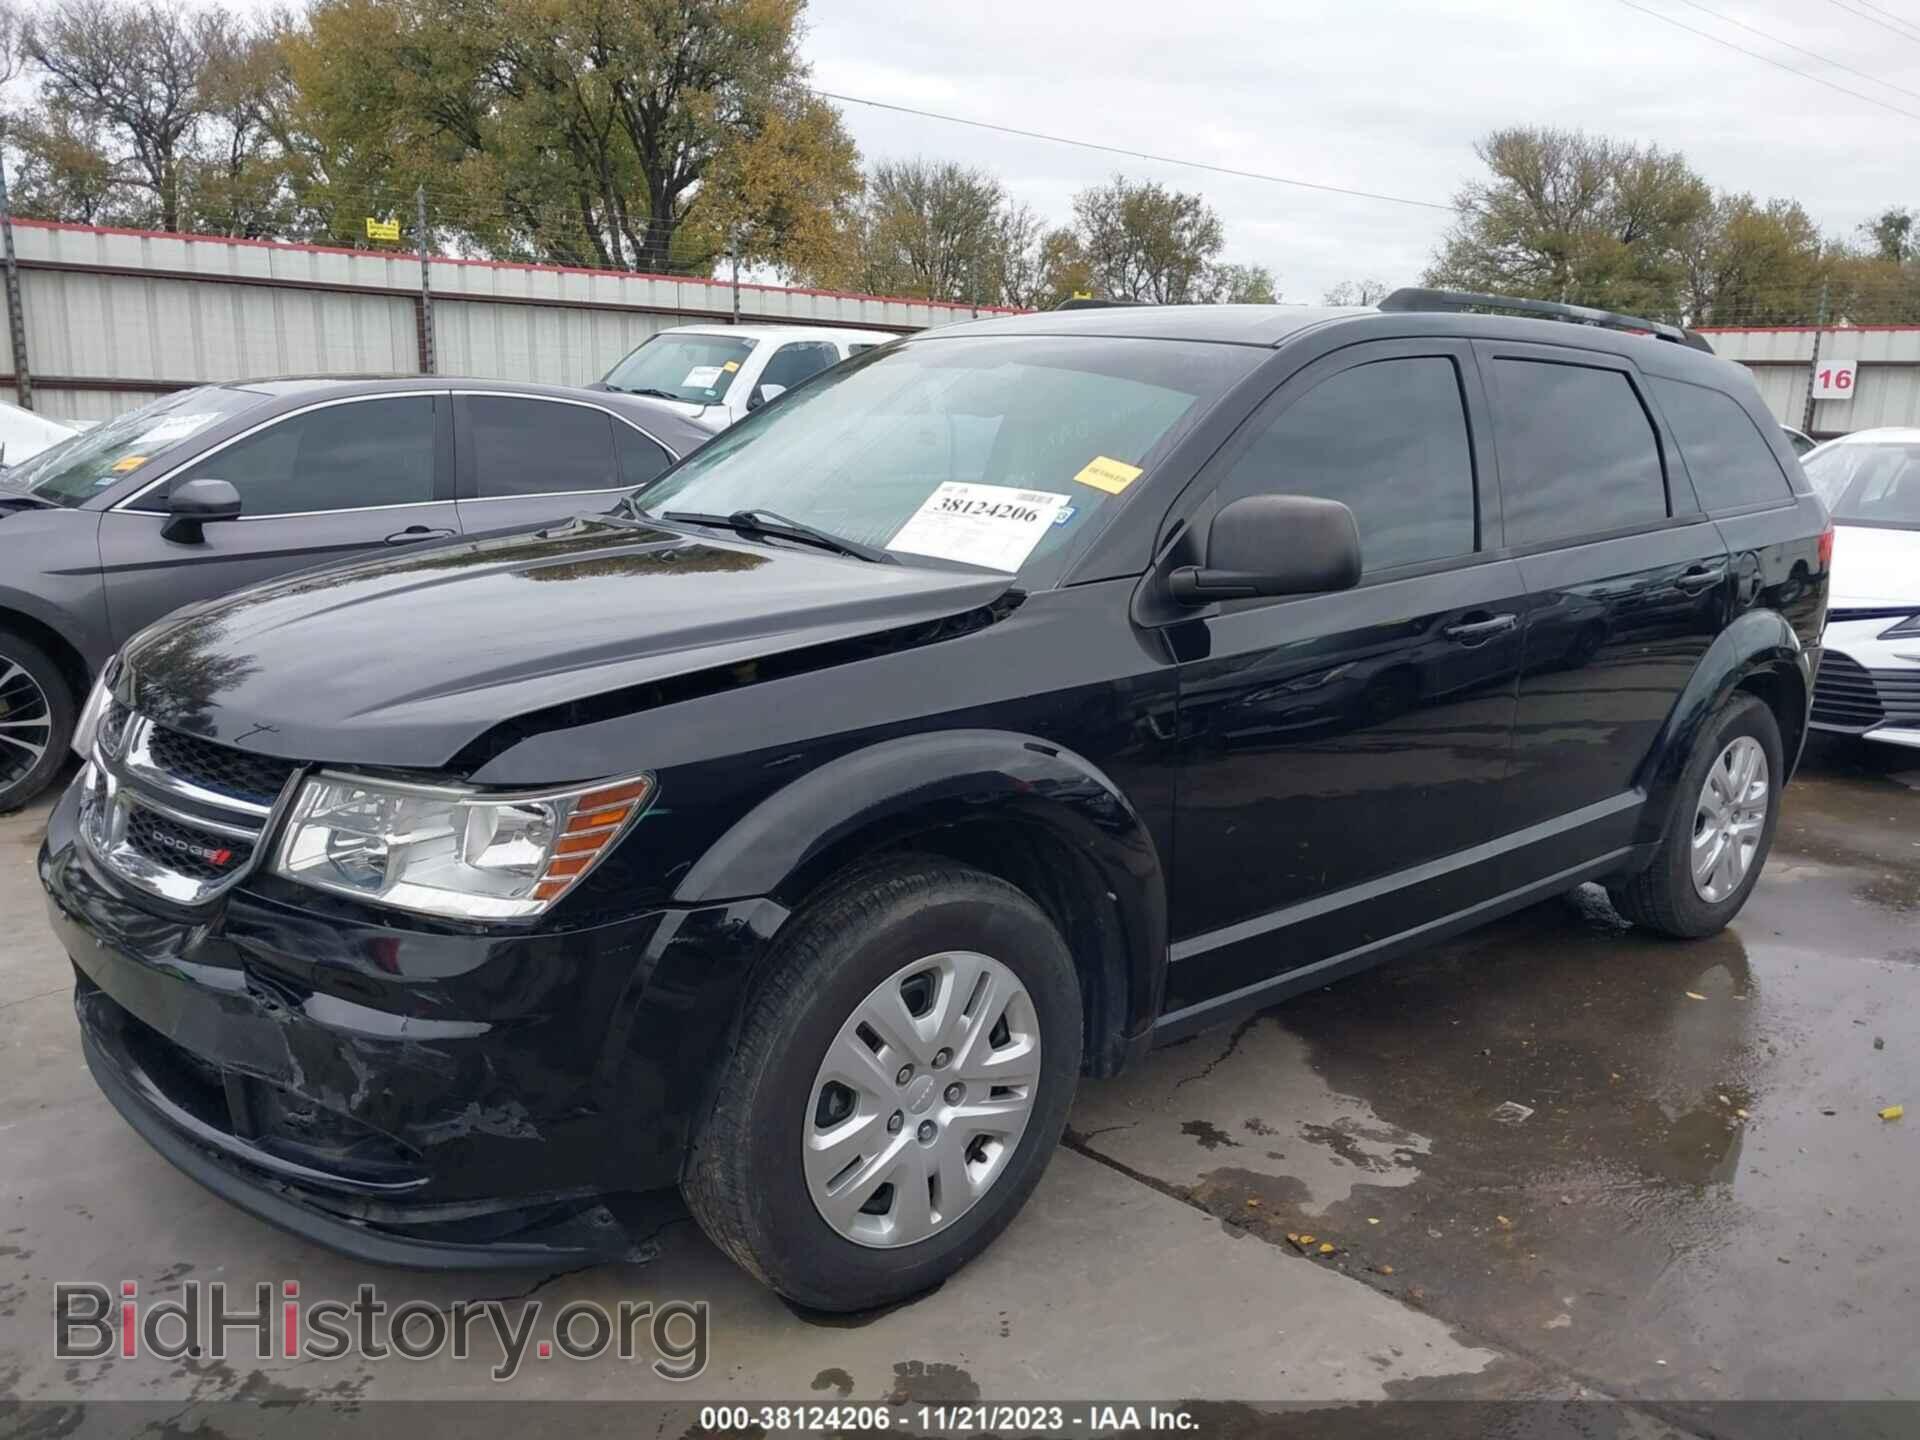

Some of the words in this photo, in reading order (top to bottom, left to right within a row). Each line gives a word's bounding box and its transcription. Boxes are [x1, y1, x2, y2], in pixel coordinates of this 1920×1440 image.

[1818, 369, 1852, 389] 16
[933, 498, 1038, 522] 38124206
[152, 829, 217, 859] DODGE
